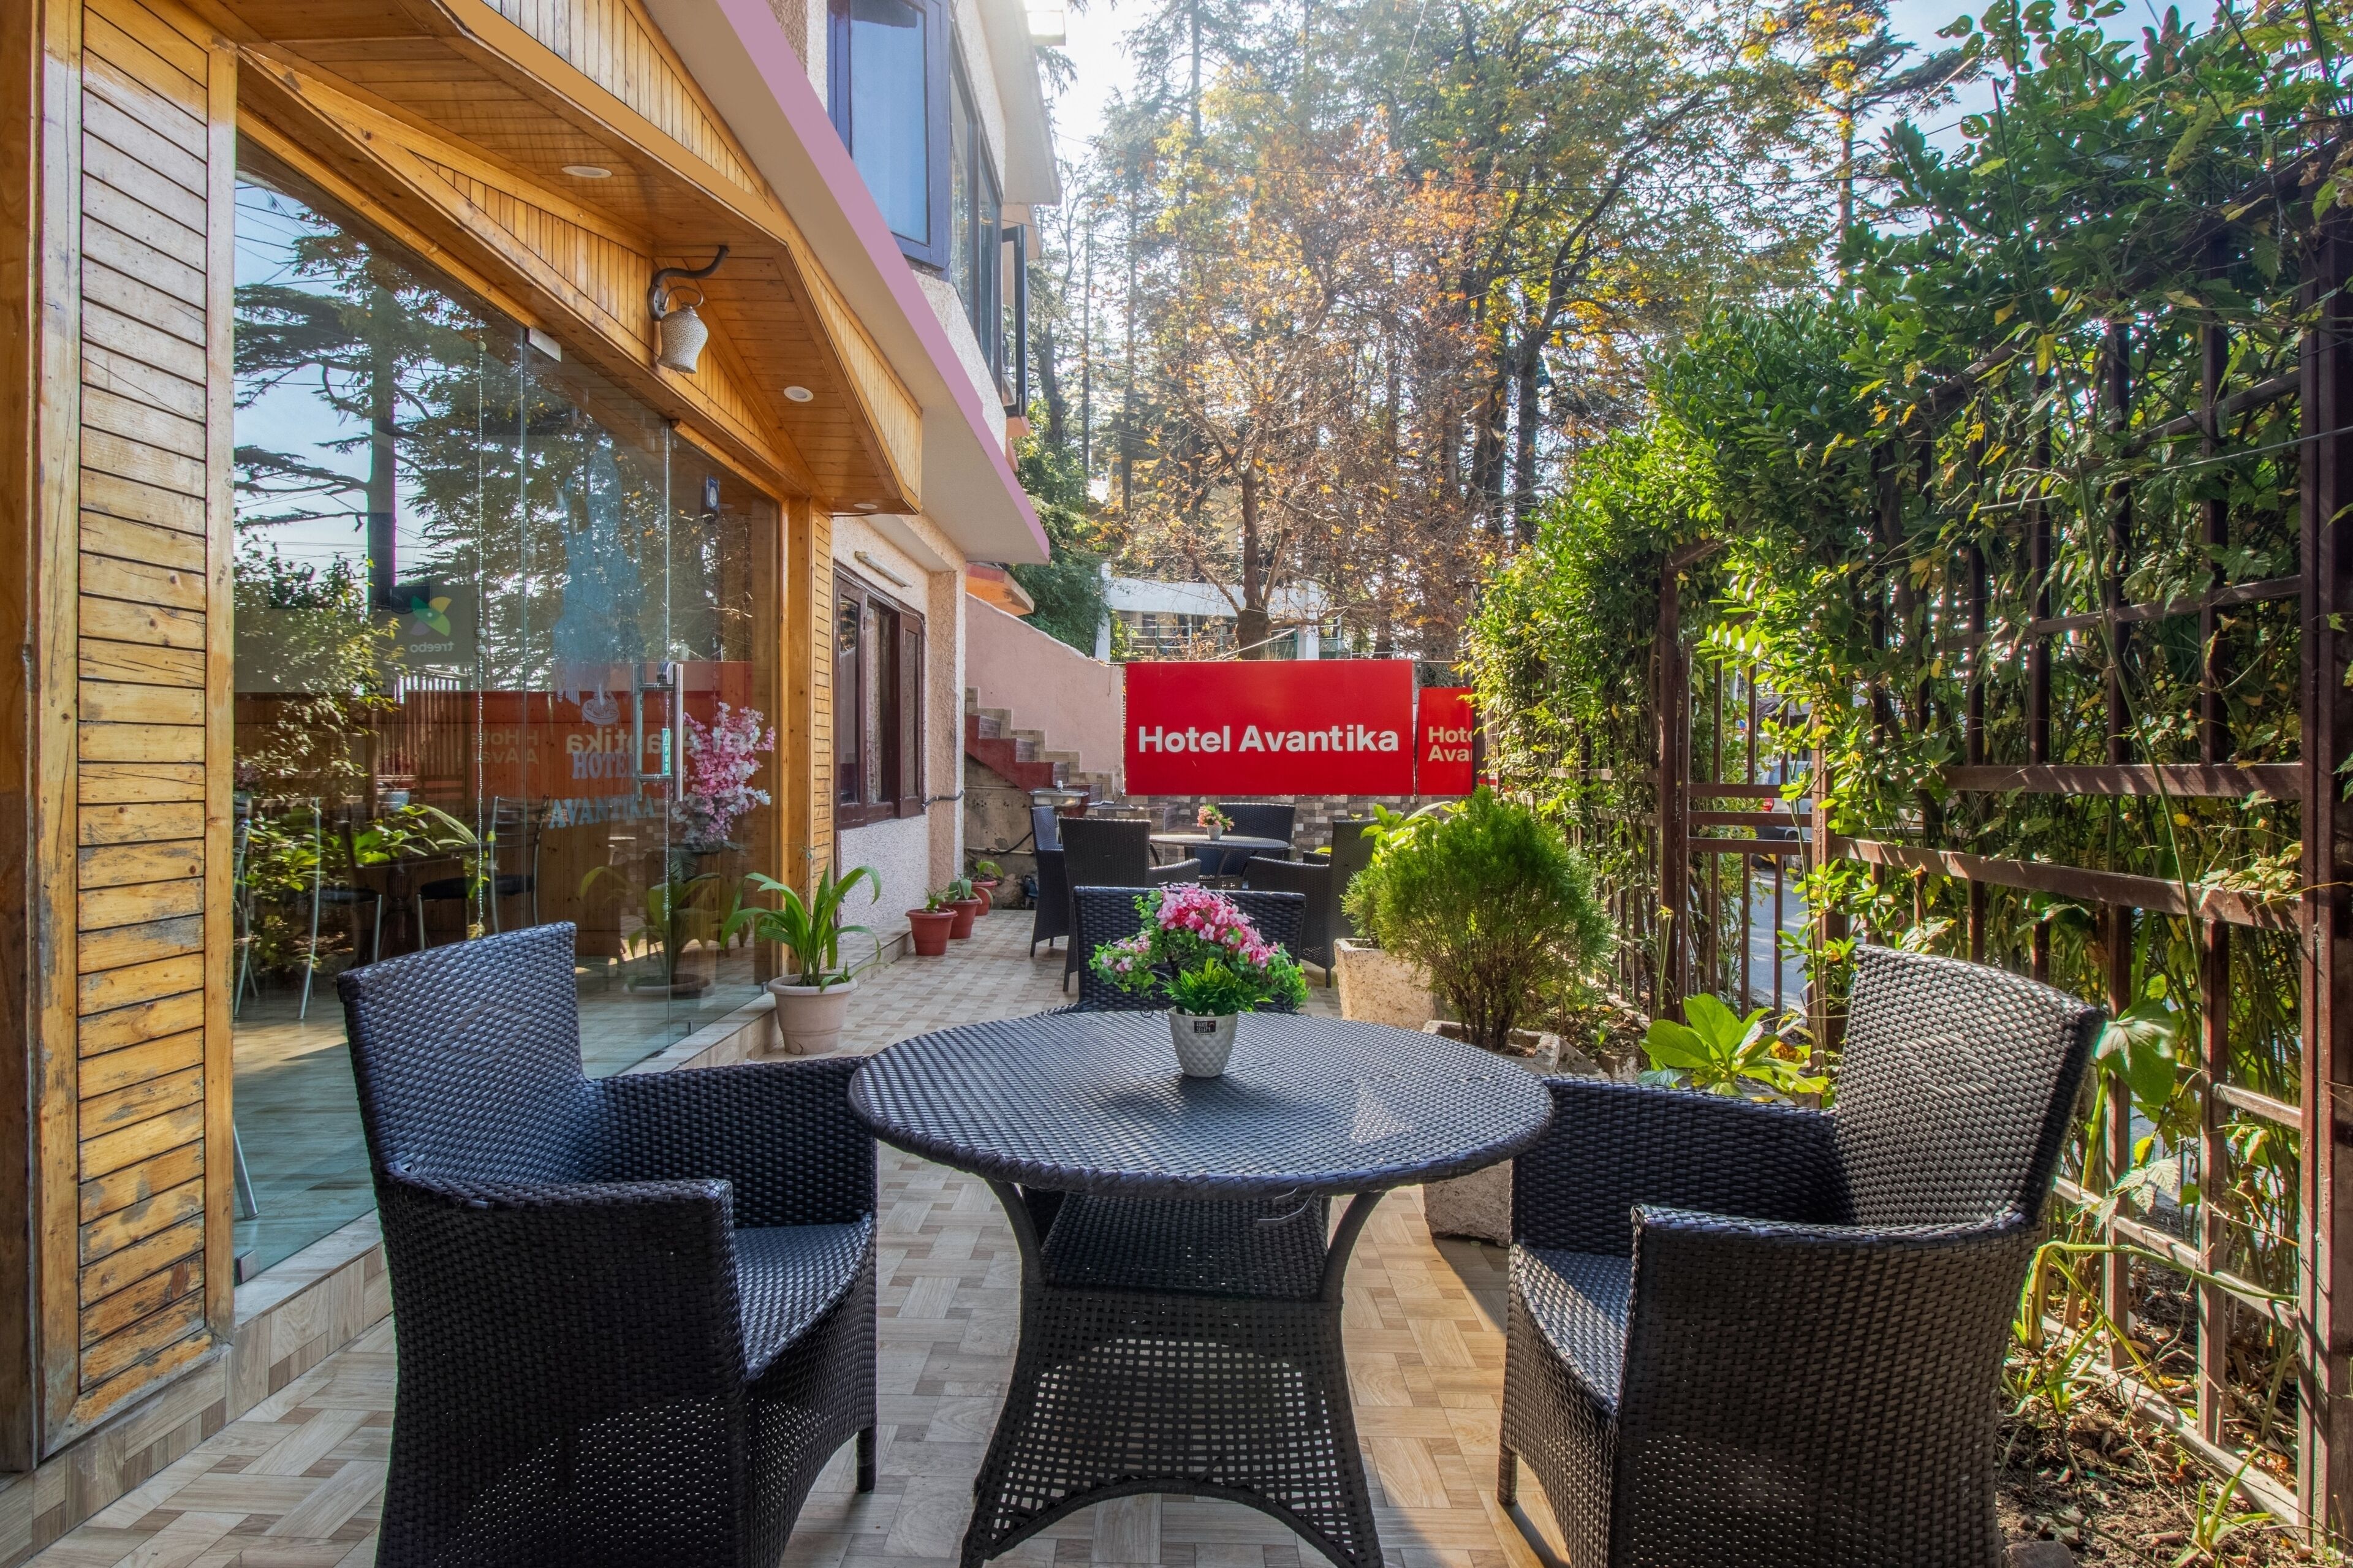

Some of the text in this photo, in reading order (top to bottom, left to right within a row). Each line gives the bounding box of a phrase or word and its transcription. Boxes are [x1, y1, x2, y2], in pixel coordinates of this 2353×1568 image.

[1138, 725, 1399, 752] Hotel Avantika
[1428, 744, 1472, 762] Ava
[548, 793, 656, 829] AVANTIKA
